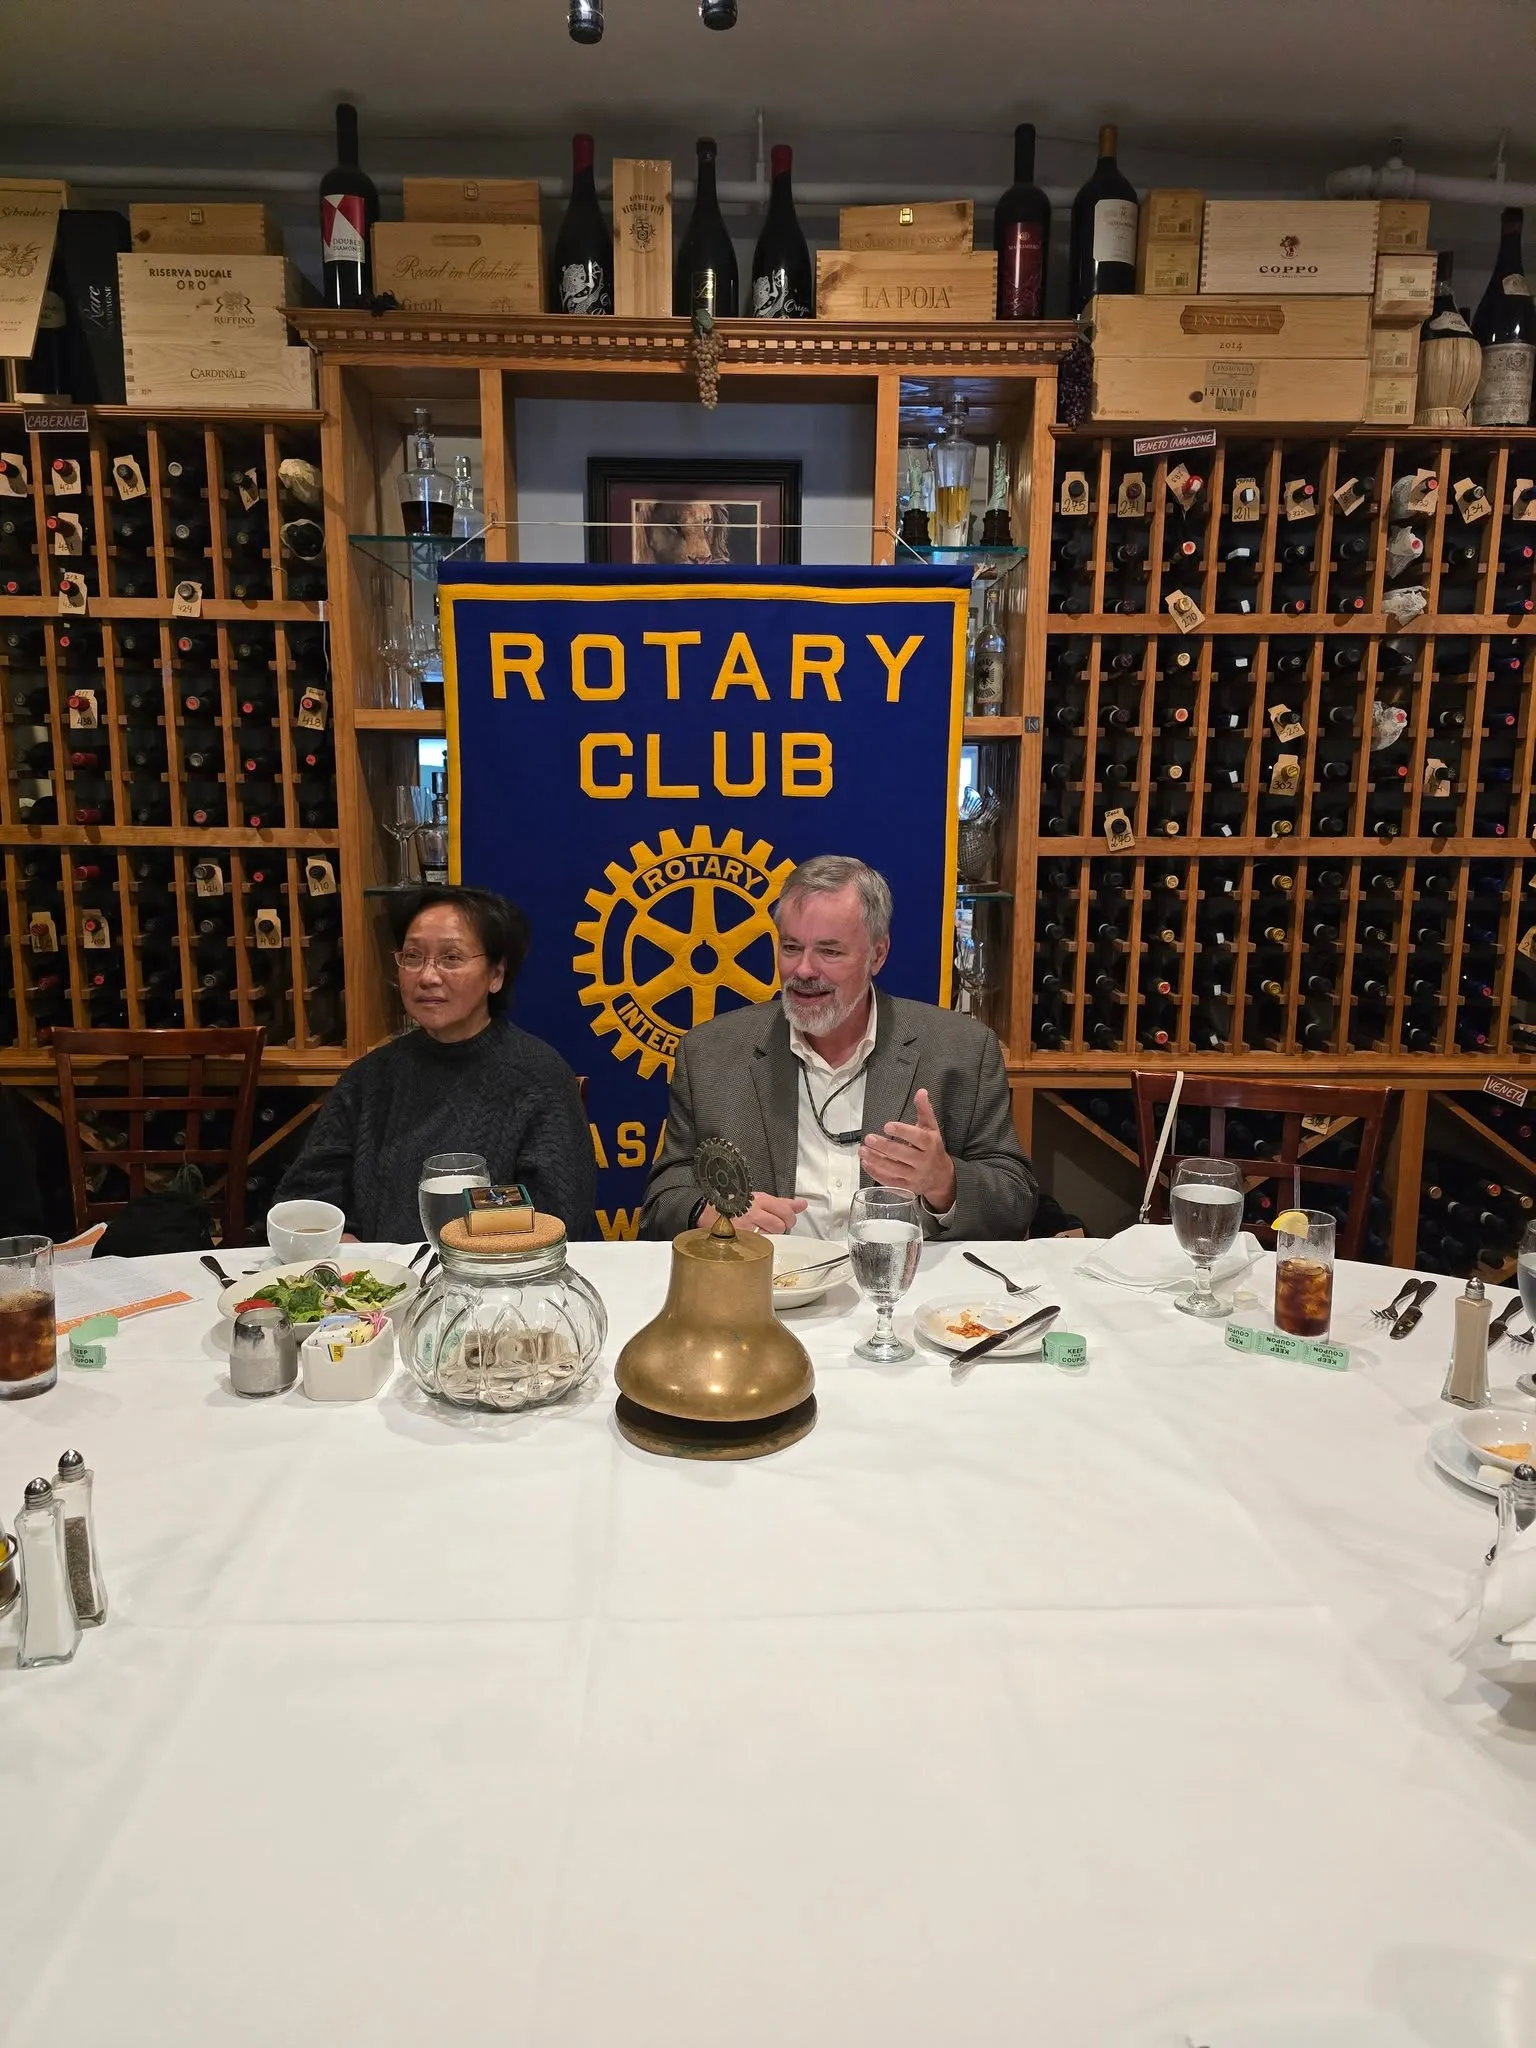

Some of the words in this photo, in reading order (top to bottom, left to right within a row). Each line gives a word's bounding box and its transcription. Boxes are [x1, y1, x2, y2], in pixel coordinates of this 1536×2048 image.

[149, 268, 192, 278] RISERVA
[194, 269, 232, 279] DUCALE
[1259, 265, 1319, 274] COPPO
[177, 279, 206, 291] ORO
[862, 286, 890, 309] LA
[214, 315, 256, 325] RUFFINO
[1193, 313, 1272, 327] INSIGNIA
[1219, 341, 1243, 351] 2014
[190, 368, 247, 380] CARDINALE
[27, 415, 86, 428] CABERNET
[1136, 440, 1168, 453] VENETO
[1061, 499, 1086, 514] 275
[1118, 500, 1139, 516] 271
[1463, 503, 1485, 521] 234
[1233, 507, 1251, 520] 211
[1181, 612, 1198, 628] 270
[489, 631, 925, 703] ROTARY
[579, 731, 835, 799] CLUB
[1272, 780, 1294, 791] 302
[1110, 832, 1132, 848] 275
[641, 855, 764, 894] ROTARY
[1266, 1336, 1296, 1348] COUPON
[1270, 1346, 1290, 1355] KEEP
[1313, 1346, 1344, 1358] COUPON
[1317, 1356, 1337, 1366] KEEP
